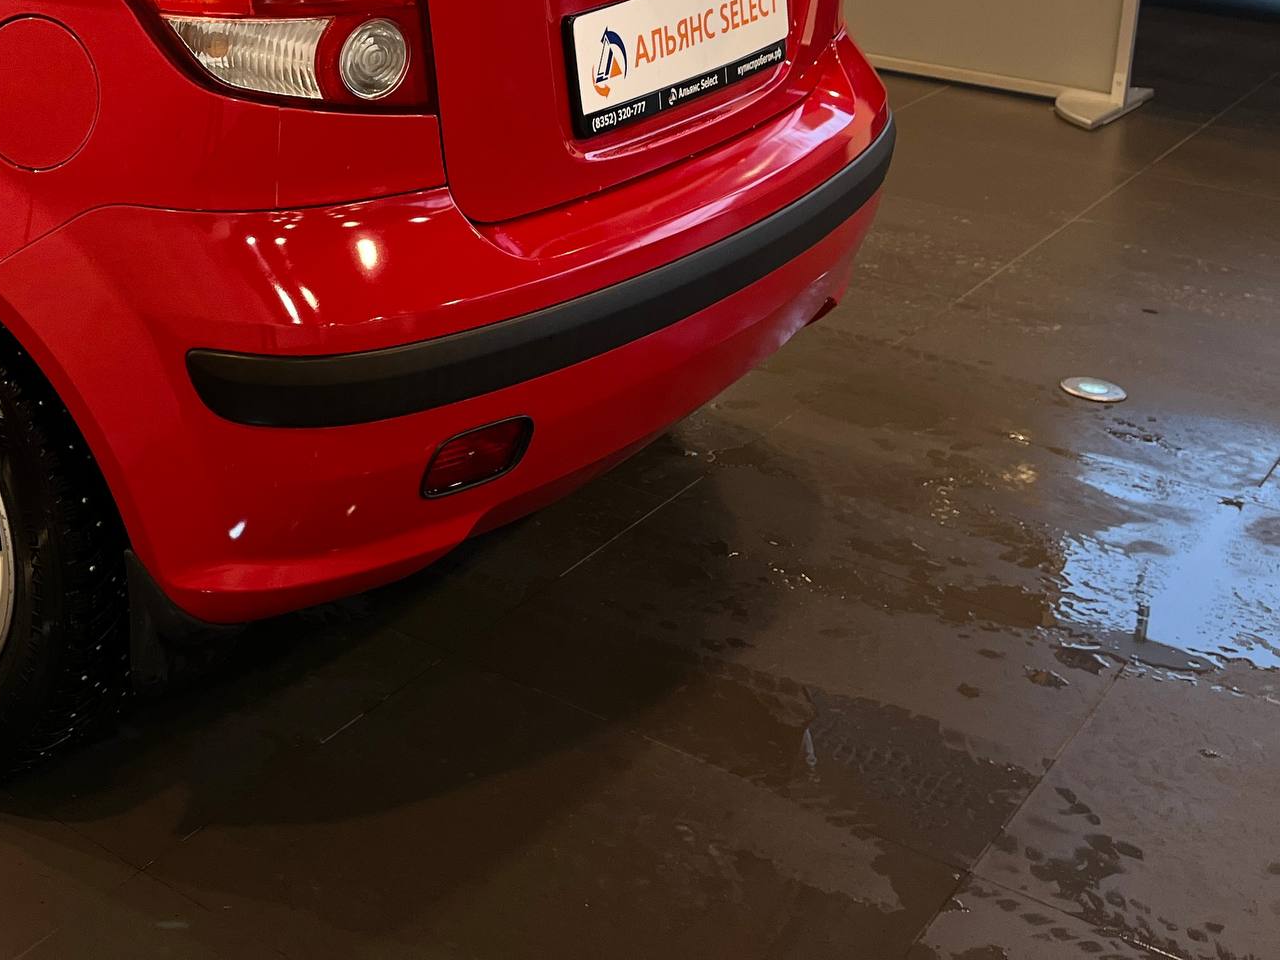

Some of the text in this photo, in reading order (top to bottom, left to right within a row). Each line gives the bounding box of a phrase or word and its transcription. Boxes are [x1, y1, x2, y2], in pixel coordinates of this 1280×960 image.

[634, 9, 716, 68] АЛЬЯНС
[678, 74, 718, 98] Альянс Select
[591, 101, 646, 132] (8352) 320-777
